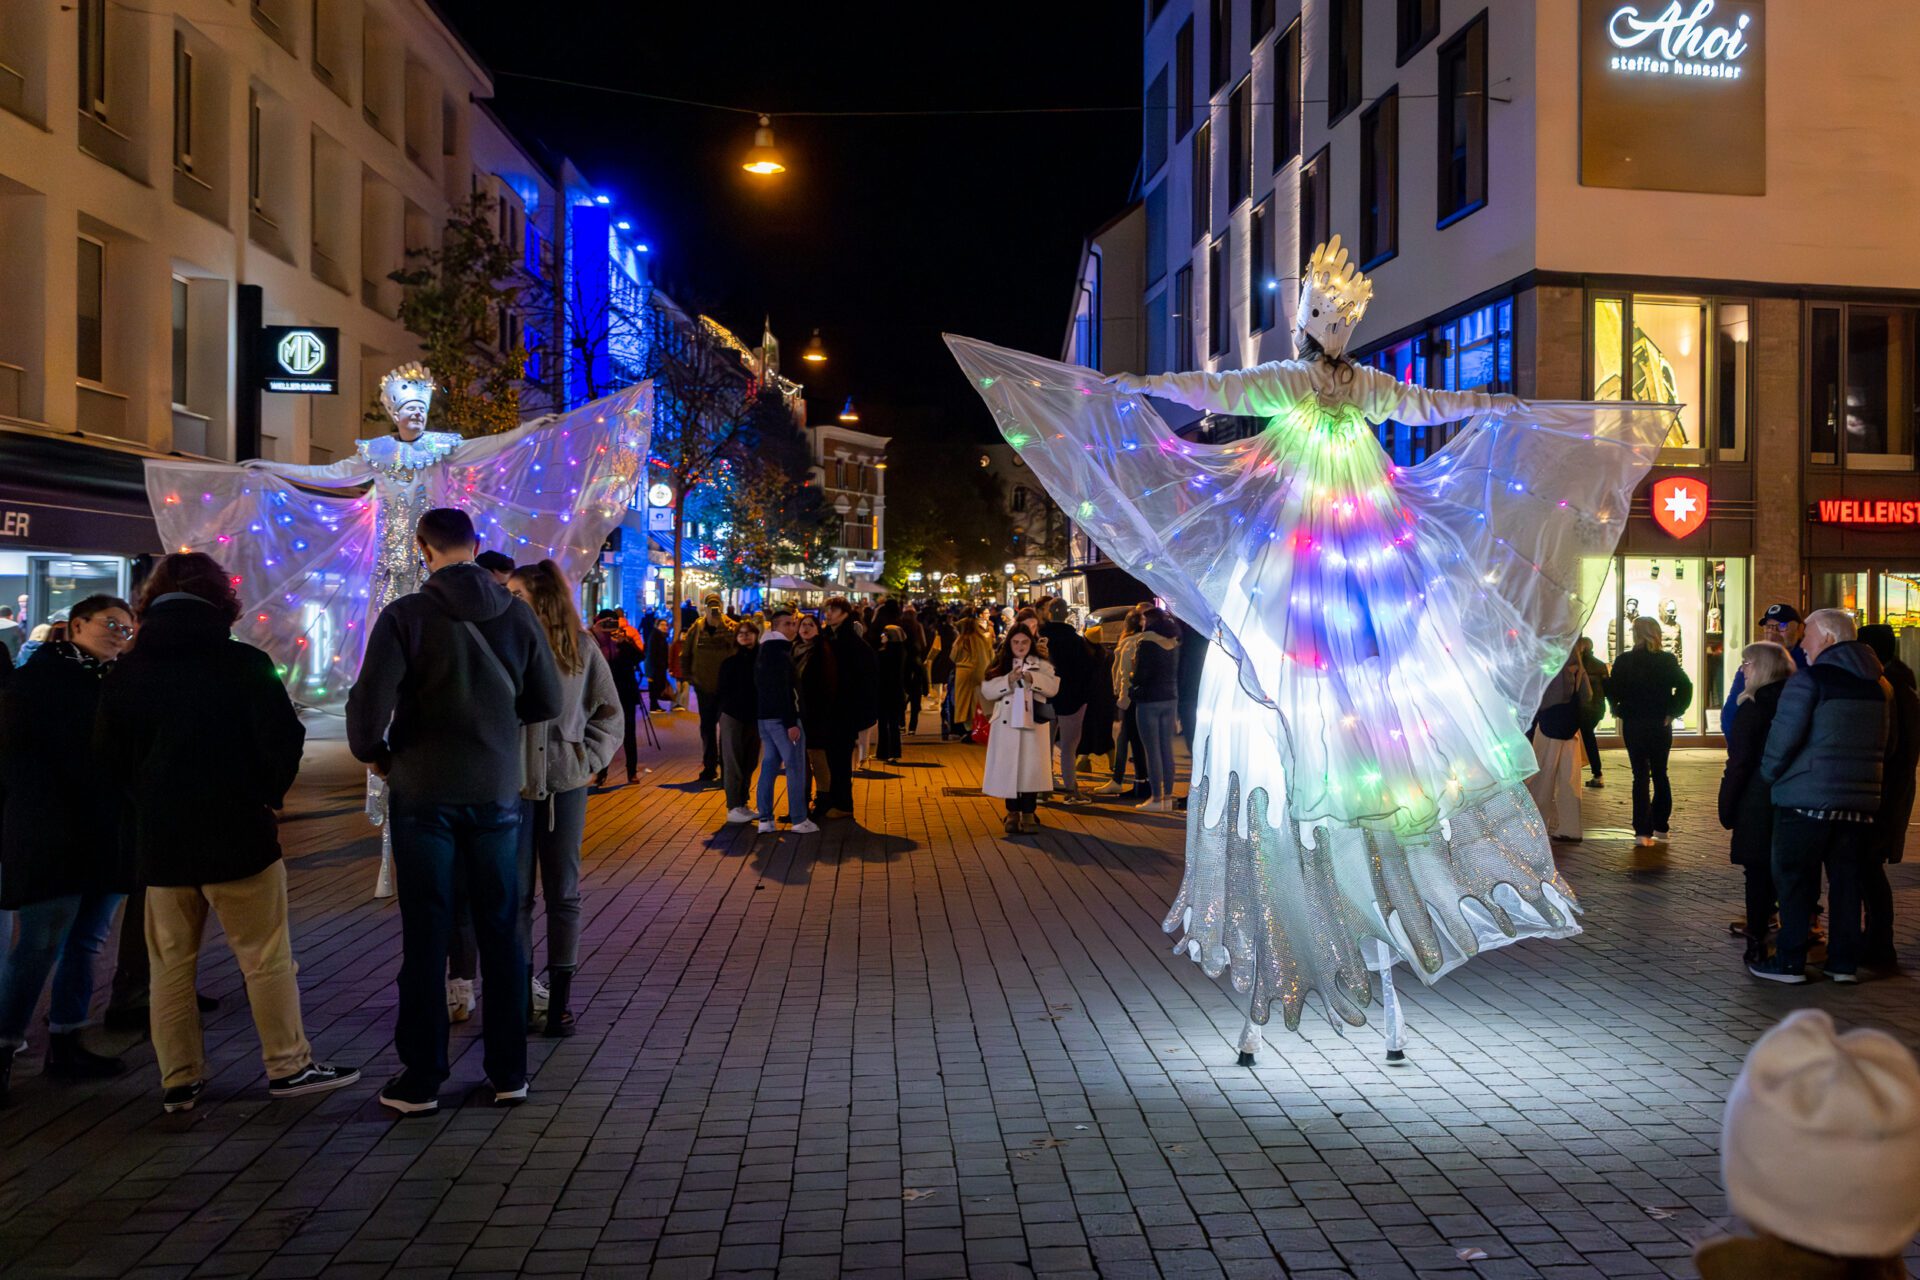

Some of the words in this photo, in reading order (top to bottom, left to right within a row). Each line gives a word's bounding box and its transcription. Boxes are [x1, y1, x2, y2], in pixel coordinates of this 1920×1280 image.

[1609, 0, 1750, 60] Ahoi
[1610, 55, 1669, 73] steffen
[1674, 59, 1741, 78] henssler
[282, 334, 321, 371] MG
